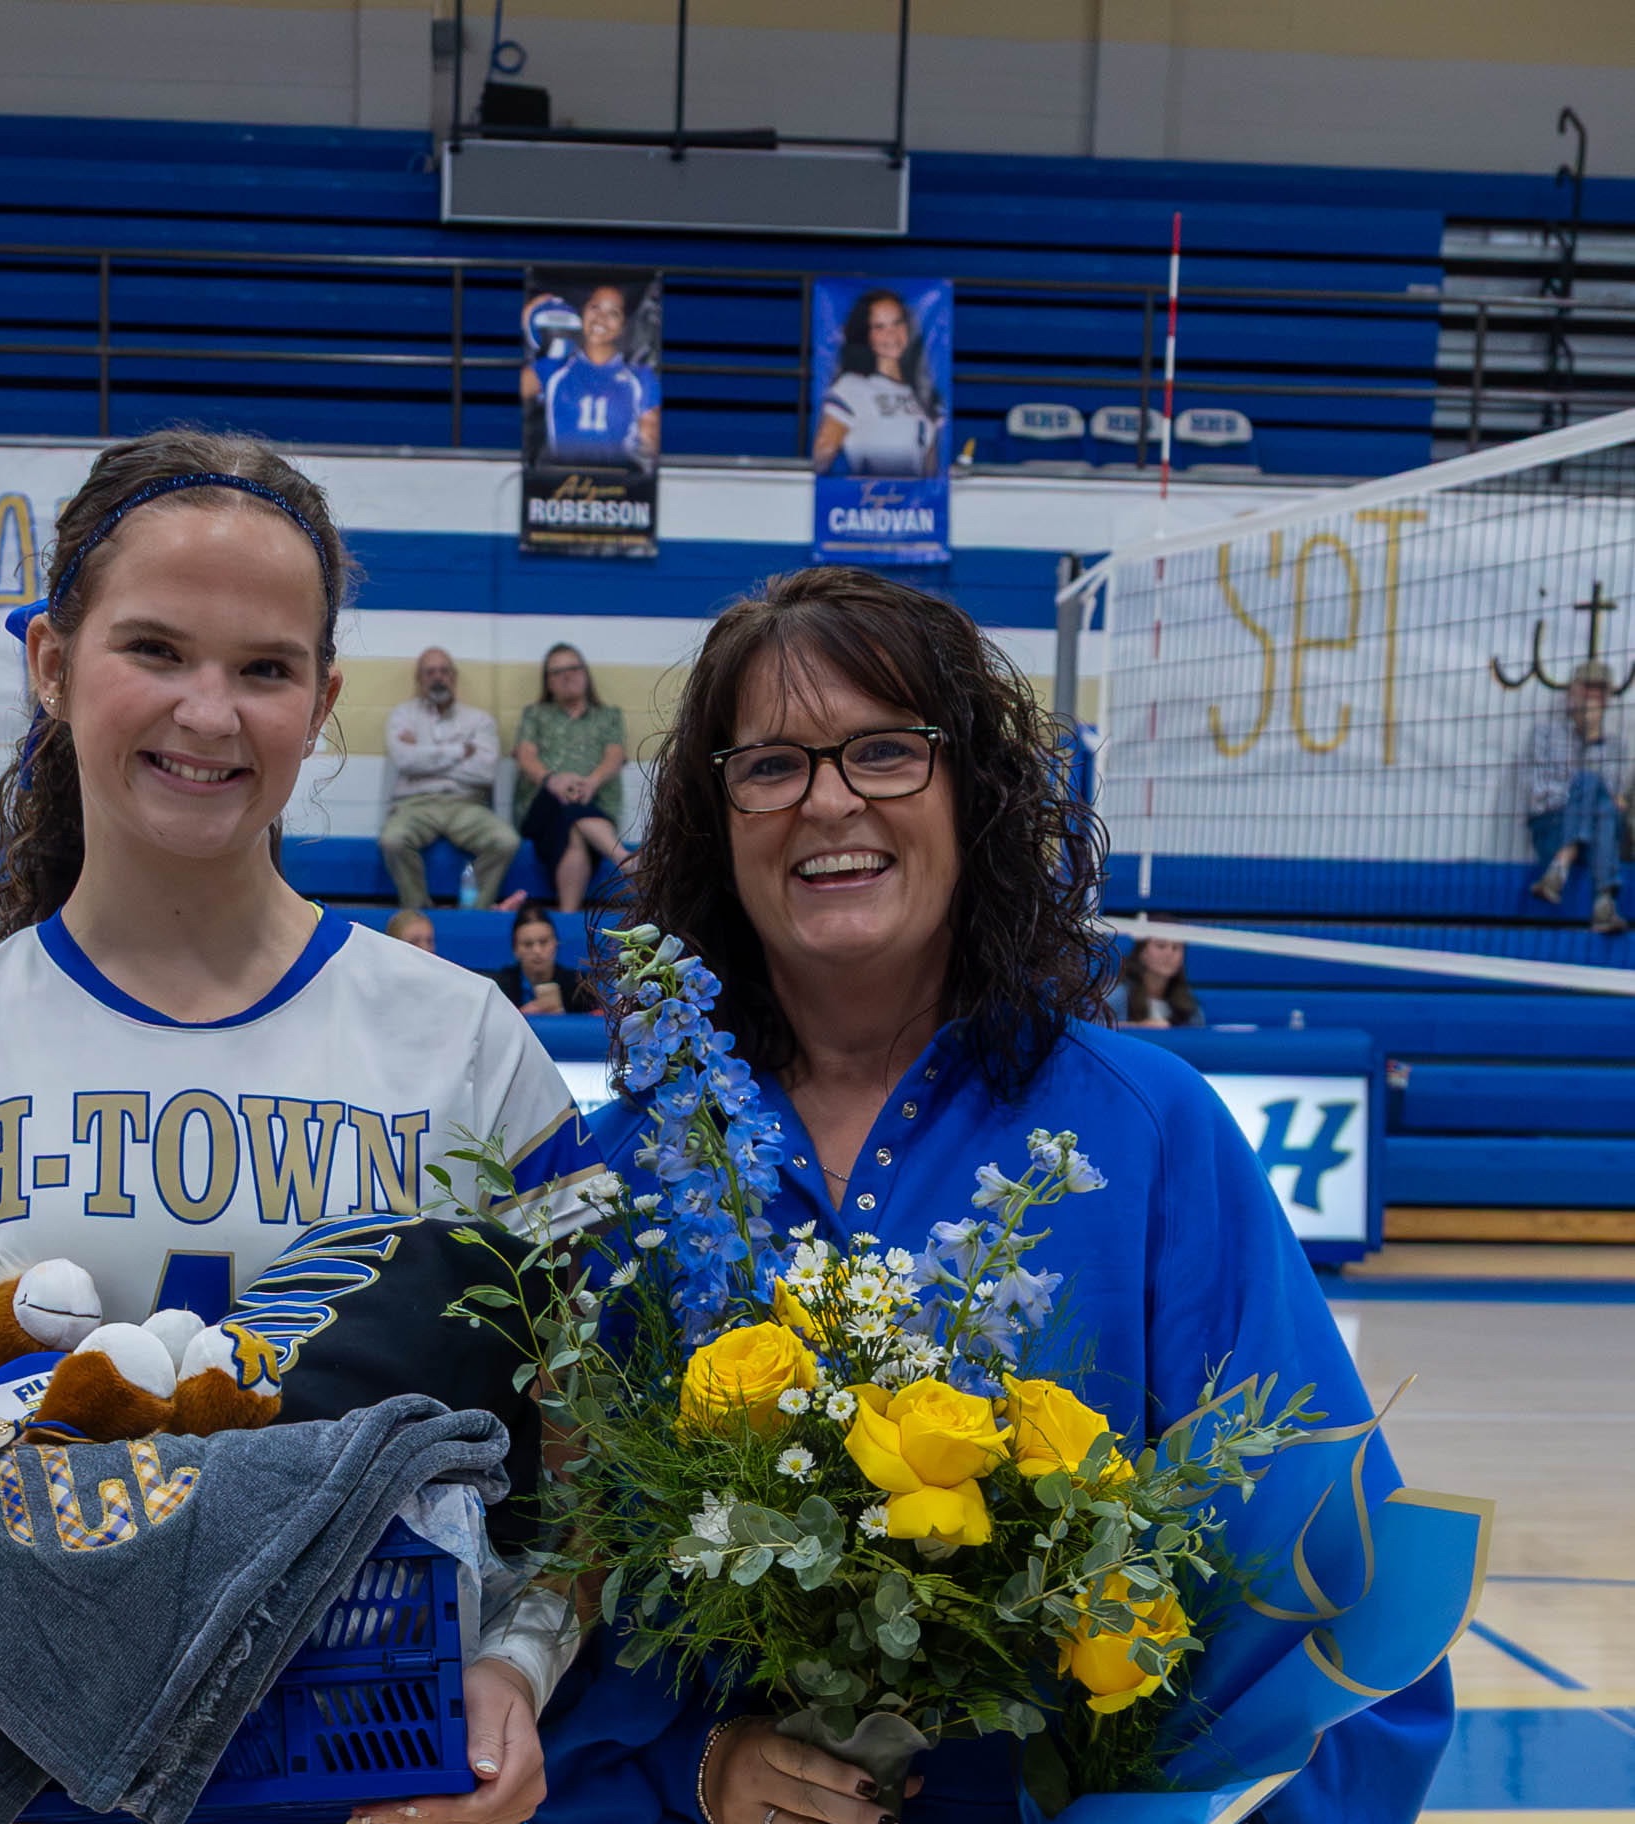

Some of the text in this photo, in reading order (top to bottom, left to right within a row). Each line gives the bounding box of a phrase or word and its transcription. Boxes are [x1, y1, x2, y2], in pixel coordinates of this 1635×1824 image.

[577, 396, 608, 430] 11
[528, 498, 650, 527] ROBERSON
[828, 507, 935, 533] CANOVAN
[13, 1375, 55, 1402] FIL
